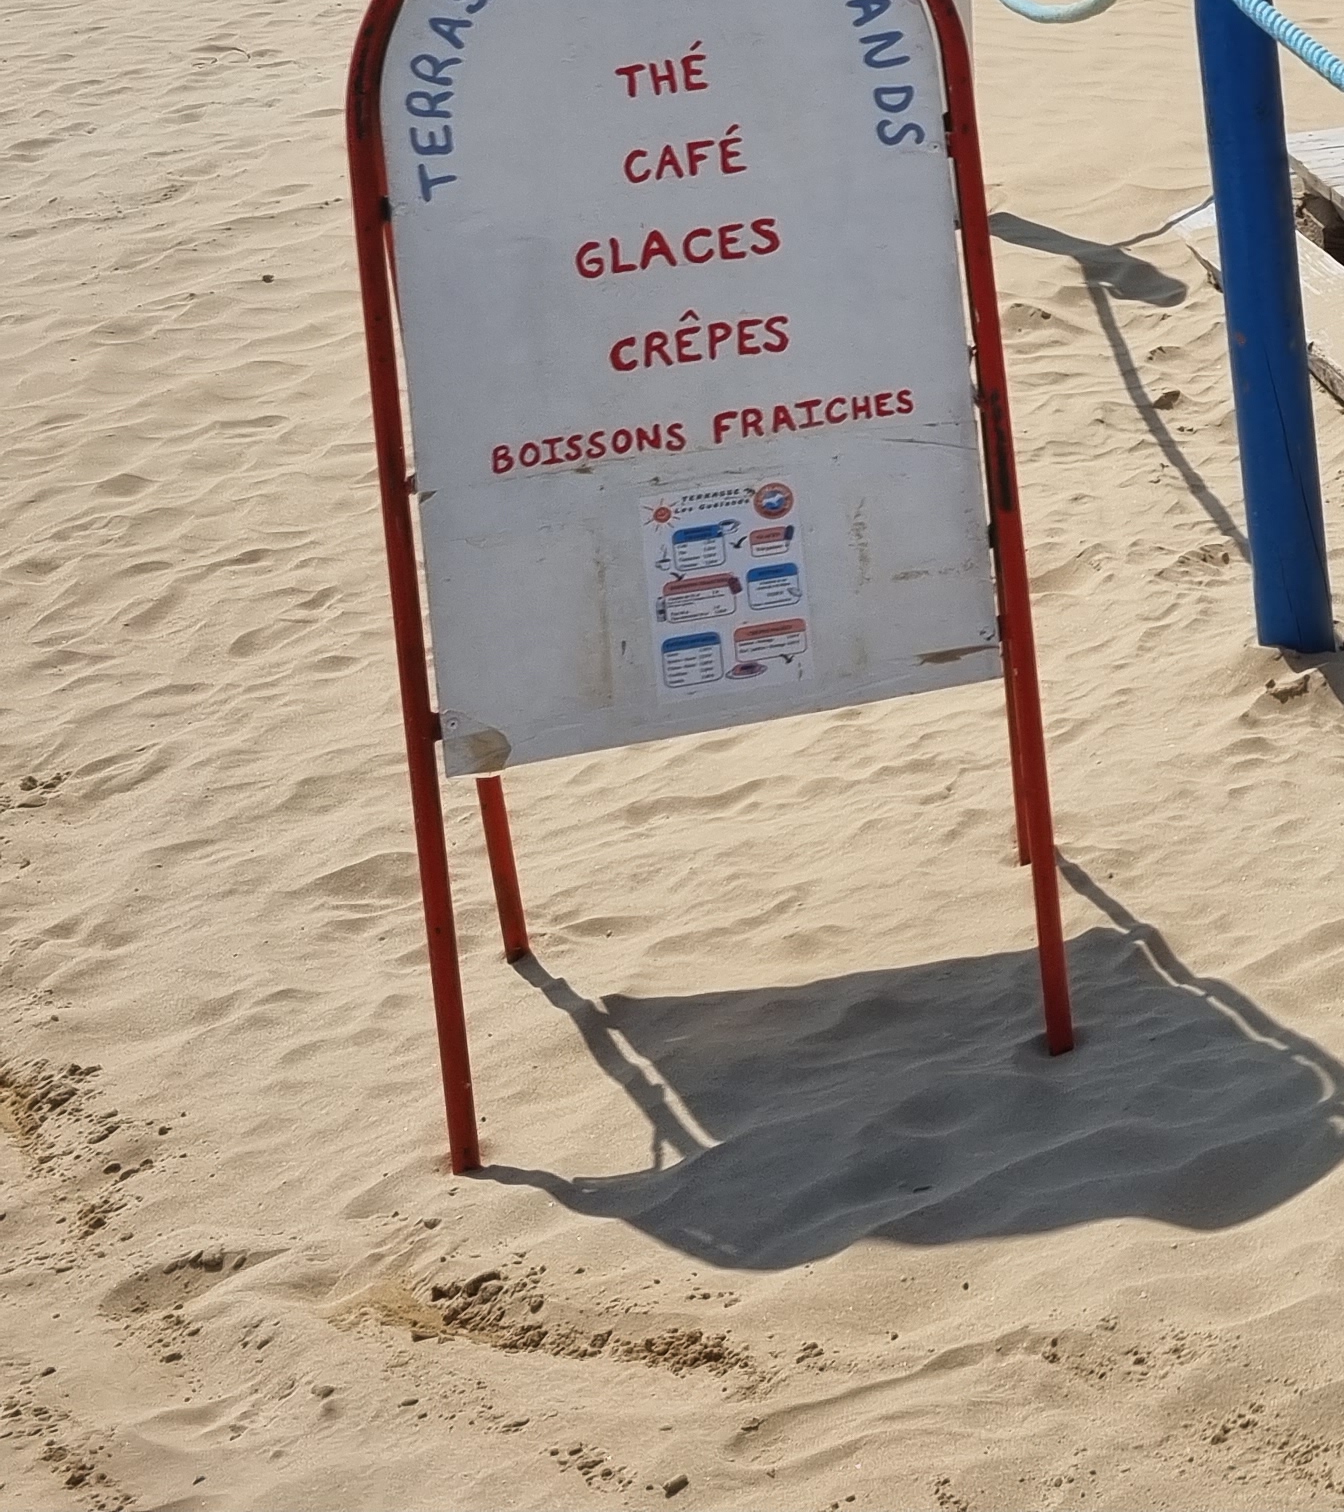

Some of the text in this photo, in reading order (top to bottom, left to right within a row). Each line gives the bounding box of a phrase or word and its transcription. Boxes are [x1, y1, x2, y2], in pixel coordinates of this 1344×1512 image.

[615, 40, 709, 98] THÉ
[623, 124, 747, 184] CAFÉ
[575, 217, 781, 279] GLACES
[609, 309, 790, 372] CRÊPES
[491, 388, 915, 474] BOISSONS FRAICHES
